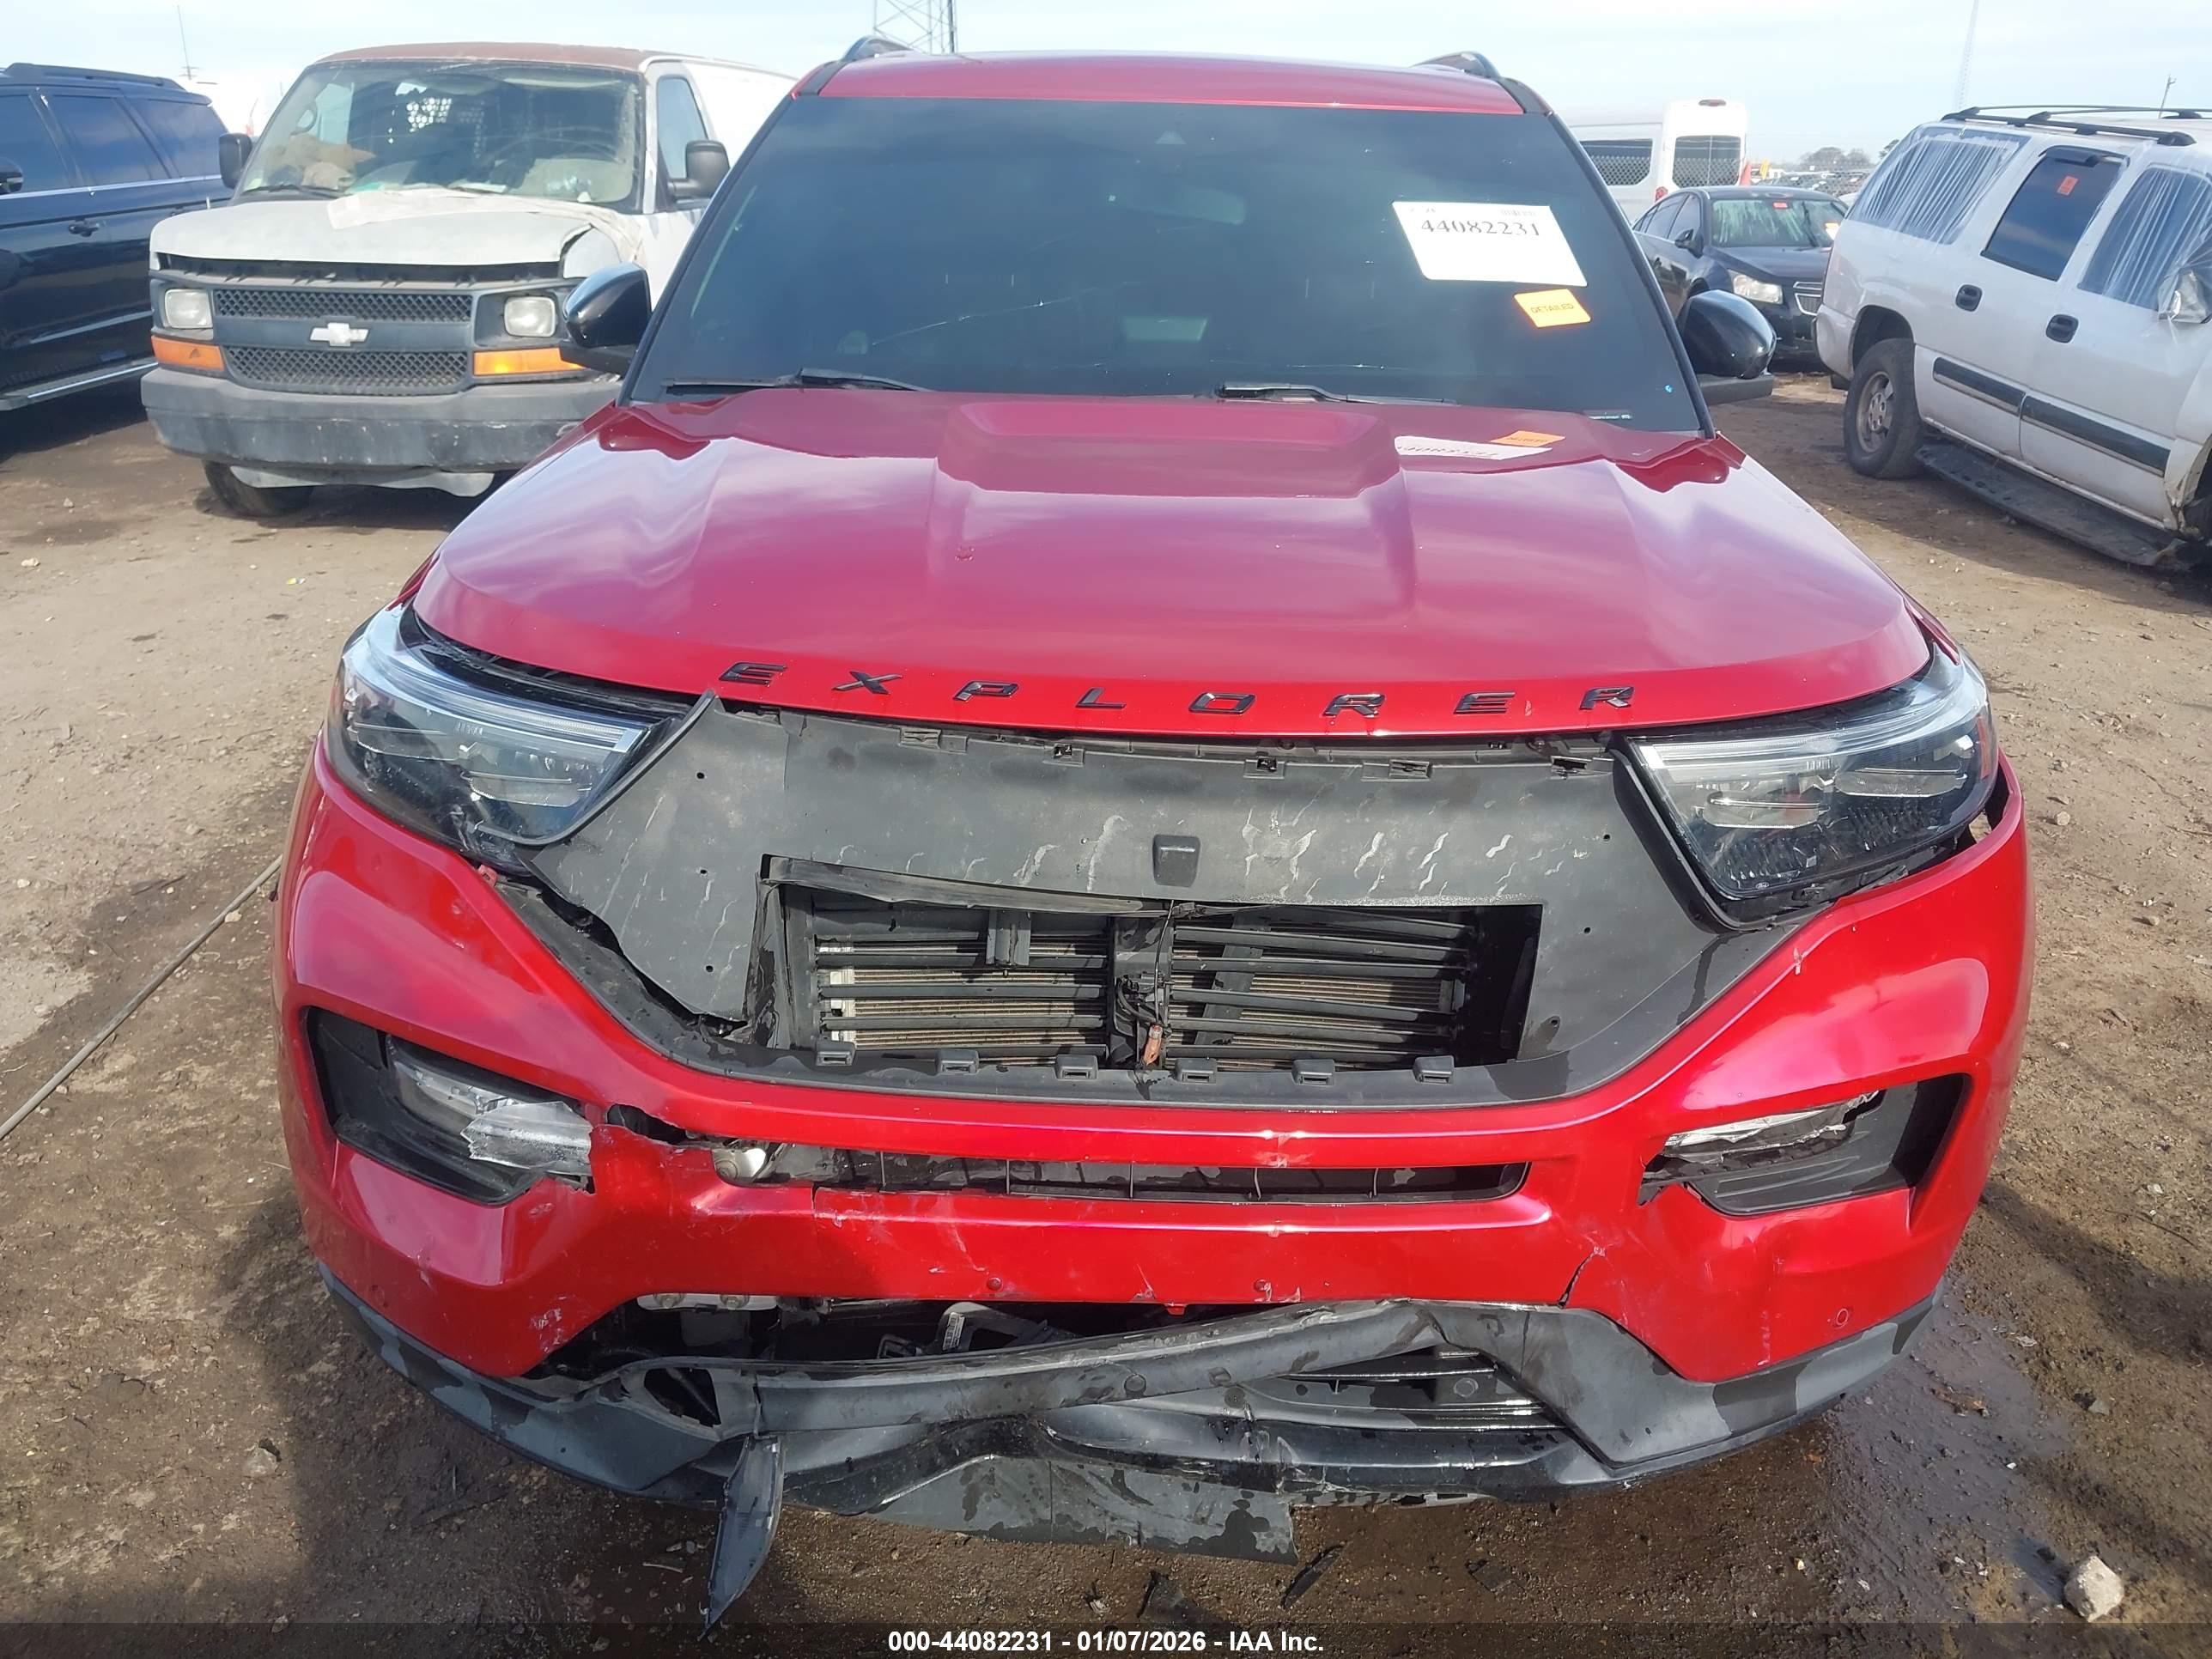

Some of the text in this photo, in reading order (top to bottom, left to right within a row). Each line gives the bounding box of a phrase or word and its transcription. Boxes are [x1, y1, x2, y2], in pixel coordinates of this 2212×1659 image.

[1421, 219, 1540, 236] 44082231
[1530, 302, 1574, 313] DETAILED
[718, 660, 1635, 717] EXPLORER
